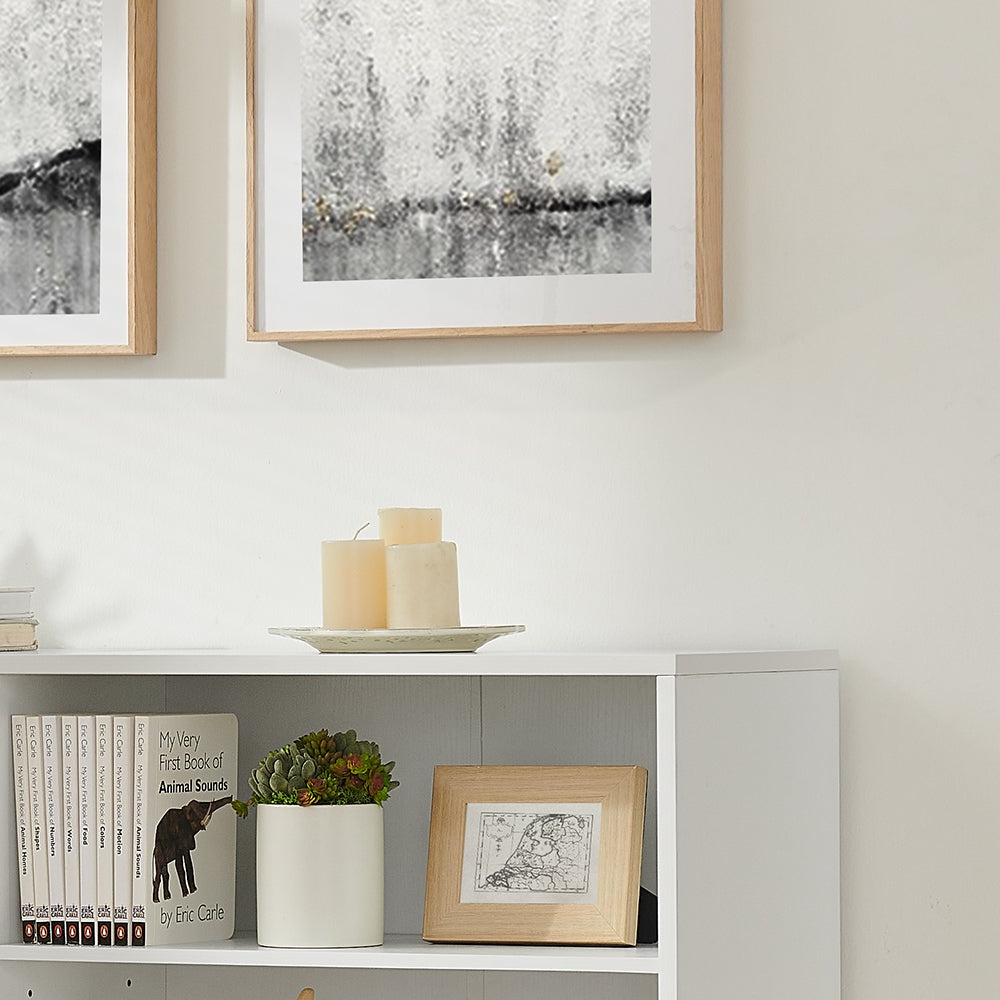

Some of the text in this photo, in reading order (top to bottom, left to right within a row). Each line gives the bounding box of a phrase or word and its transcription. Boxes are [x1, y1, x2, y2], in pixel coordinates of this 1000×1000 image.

[45, 739, 53, 757] Carle
[160, 730, 201, 753] My Very
[159, 752, 225, 771] First Book of
[159, 777, 229, 794] Animal Sounds
[160, 903, 225, 929] by Eric Carle
